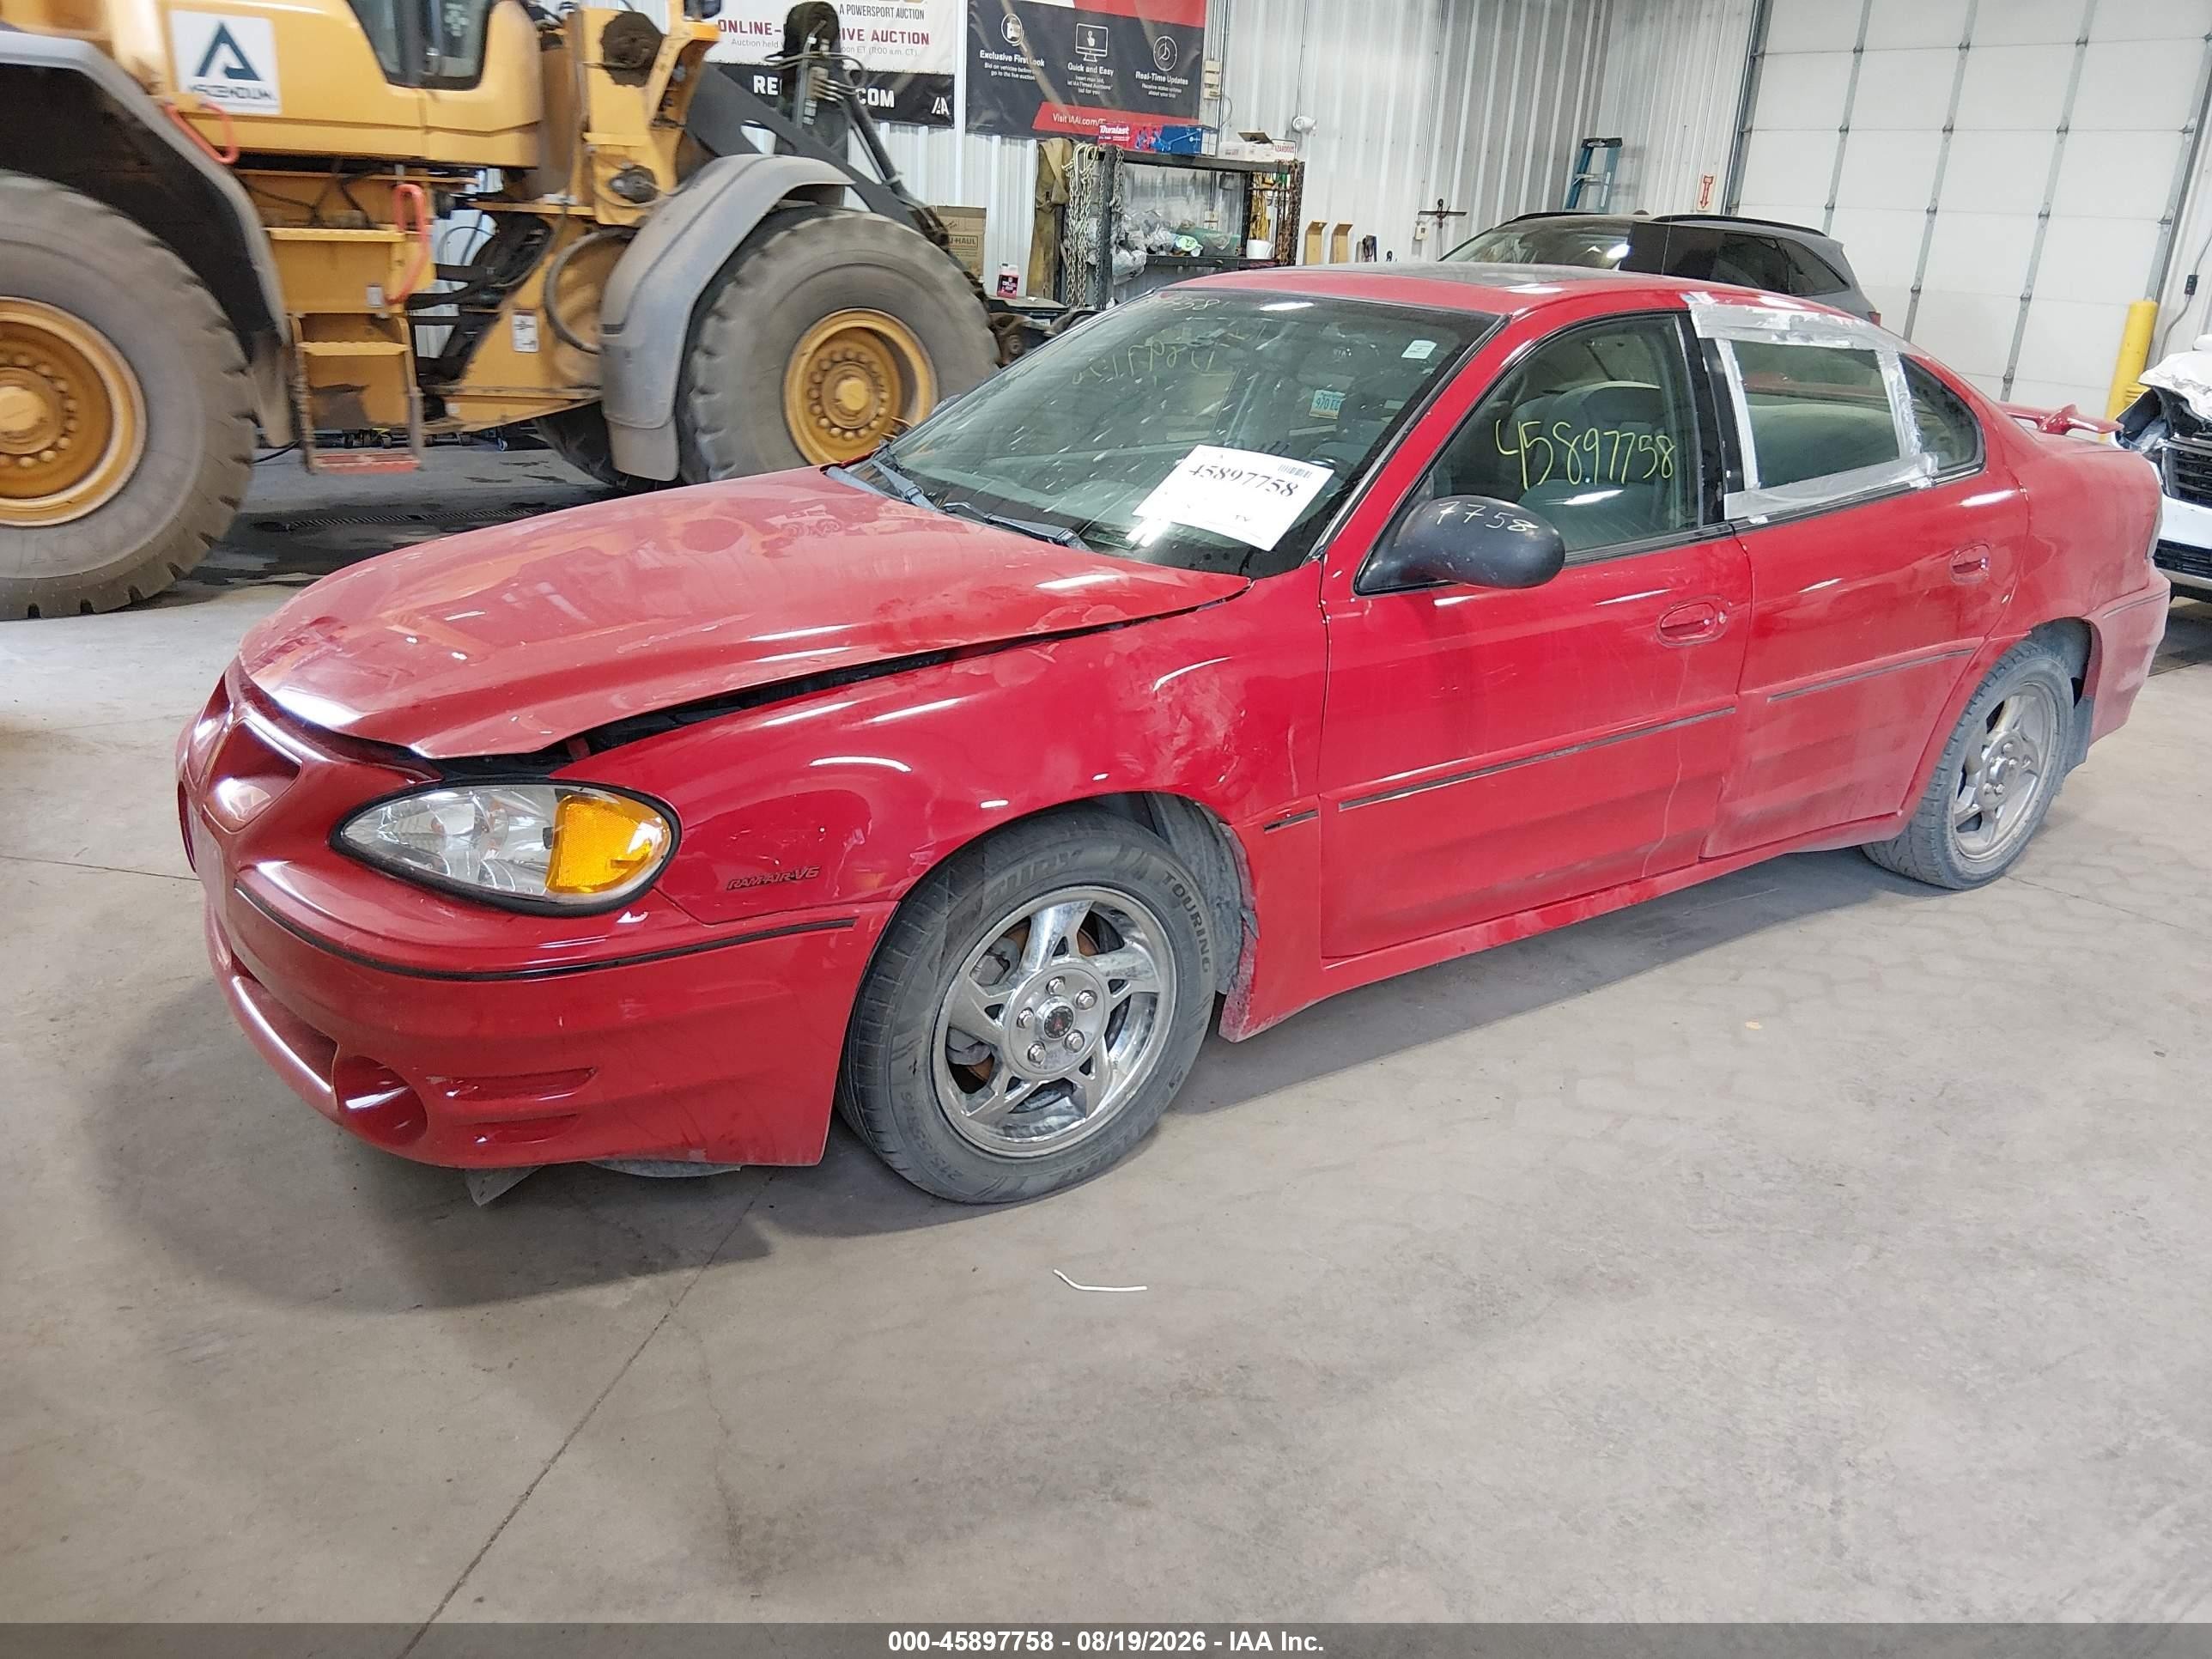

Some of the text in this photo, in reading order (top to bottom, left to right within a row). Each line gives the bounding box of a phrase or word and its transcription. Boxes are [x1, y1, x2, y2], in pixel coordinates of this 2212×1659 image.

[840, 3, 925, 20] A POWERSPORT AUCTION
[718, 19, 930, 46] ONLINE- IVE AUCTION
[732, 39, 761, 48] Auction
[979, 49, 1012, 62] Exclusive
[1067, 62, 1114, 77] Quick and Easy
[1135, 70, 1188, 85] Real-Time Updates
[753, 75, 782, 95] RE
[1053, 112, 1067, 124] Visit
[1495, 419, 1675, 489] 45897758
[1188, 464, 1298, 497] 45897758
[1437, 501, 1539, 532] 7758
[1162, 871, 1211, 973] TOURING
